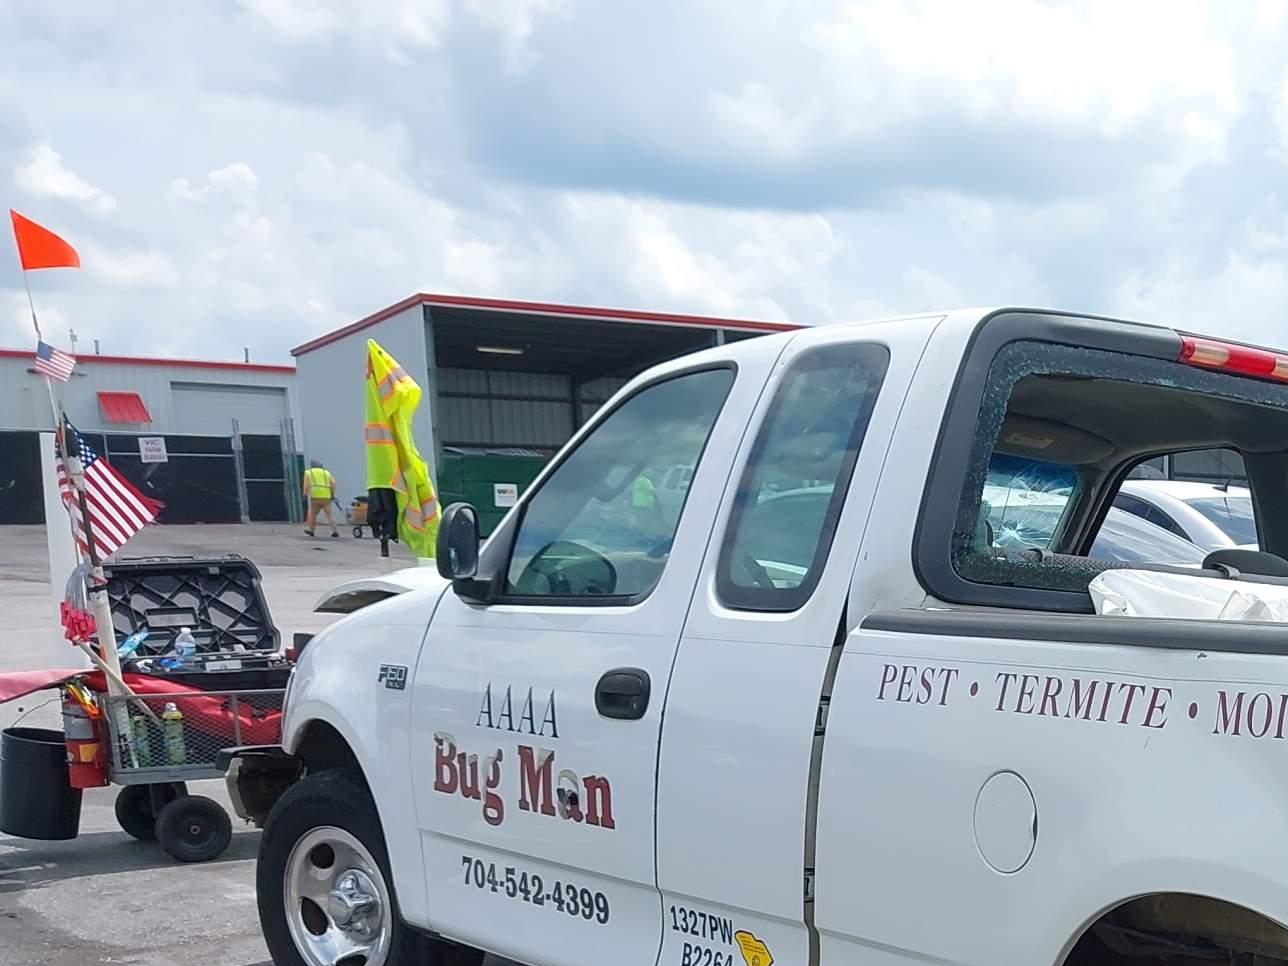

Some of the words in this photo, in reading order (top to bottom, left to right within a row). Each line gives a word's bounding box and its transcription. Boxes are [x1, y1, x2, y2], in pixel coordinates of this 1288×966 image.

[476, 681, 561, 739] AAAA
[876, 663, 960, 706] PEST
[994, 671, 1173, 729] TERMITE
[433, 731, 504, 827] Bug
[517, 744, 616, 830] Man
[461, 855, 611, 925] 704-542-4399
[670, 905, 734, 946] 1327PW
